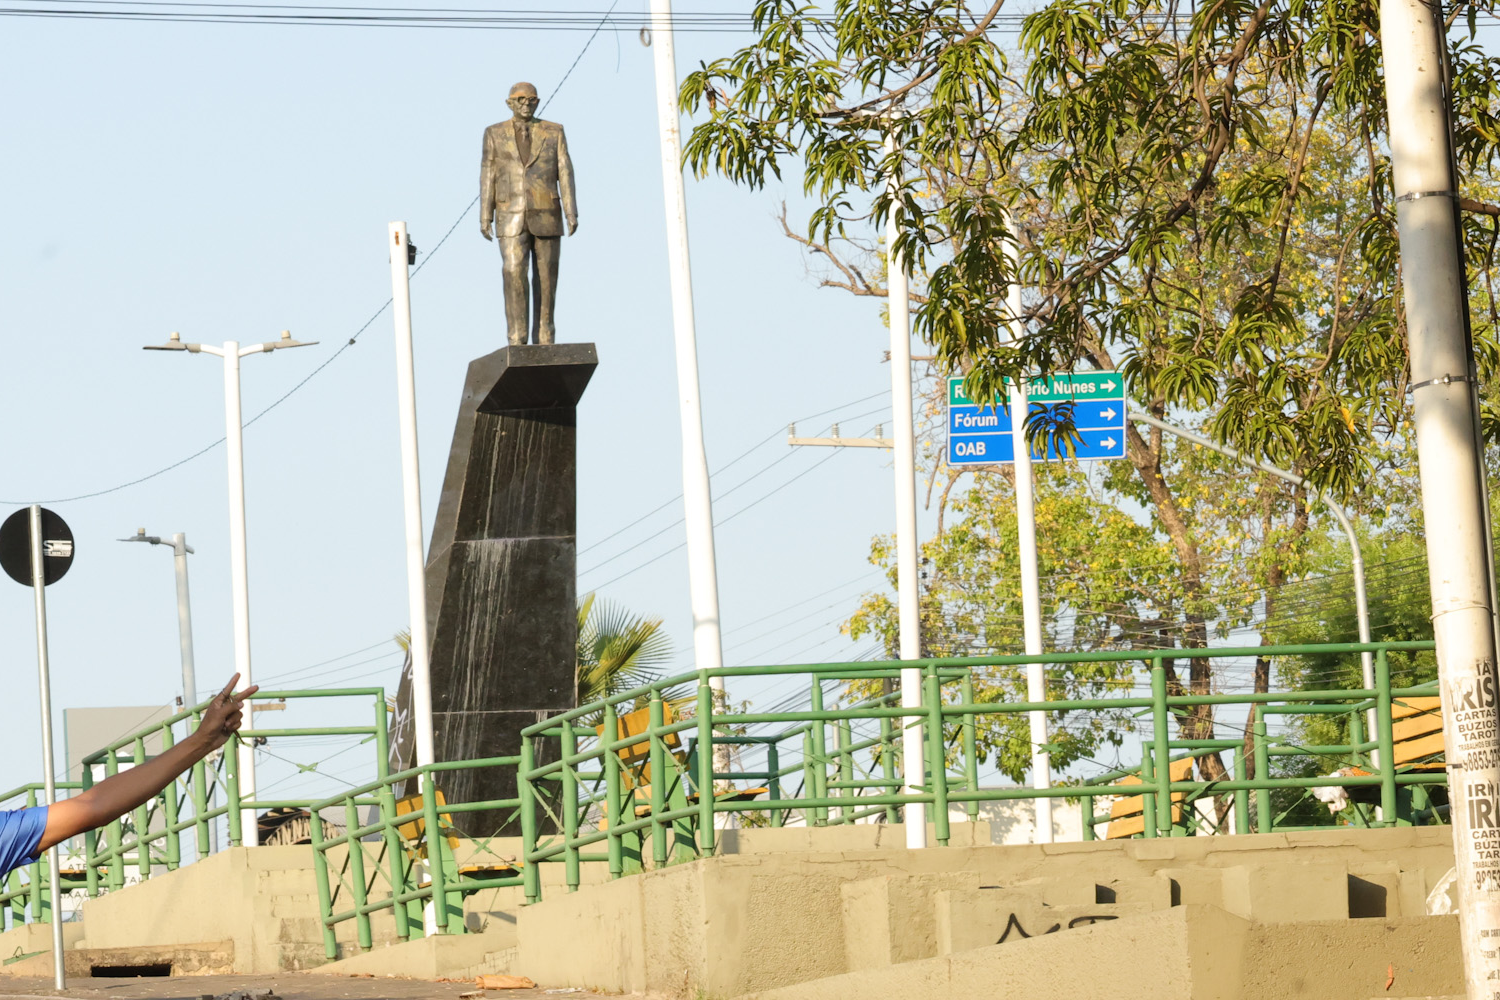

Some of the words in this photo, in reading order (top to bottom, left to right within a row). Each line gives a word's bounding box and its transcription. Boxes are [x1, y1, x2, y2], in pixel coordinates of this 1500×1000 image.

[1053, 380, 1096, 395] Nunes
[955, 413, 998, 428] Fórum
[955, 441, 986, 456] OAB
[1455, 708, 1496, 722] CARTAS
[1458, 719, 1497, 733] BÚZIOS
[1462, 729, 1496, 741] TAROT
